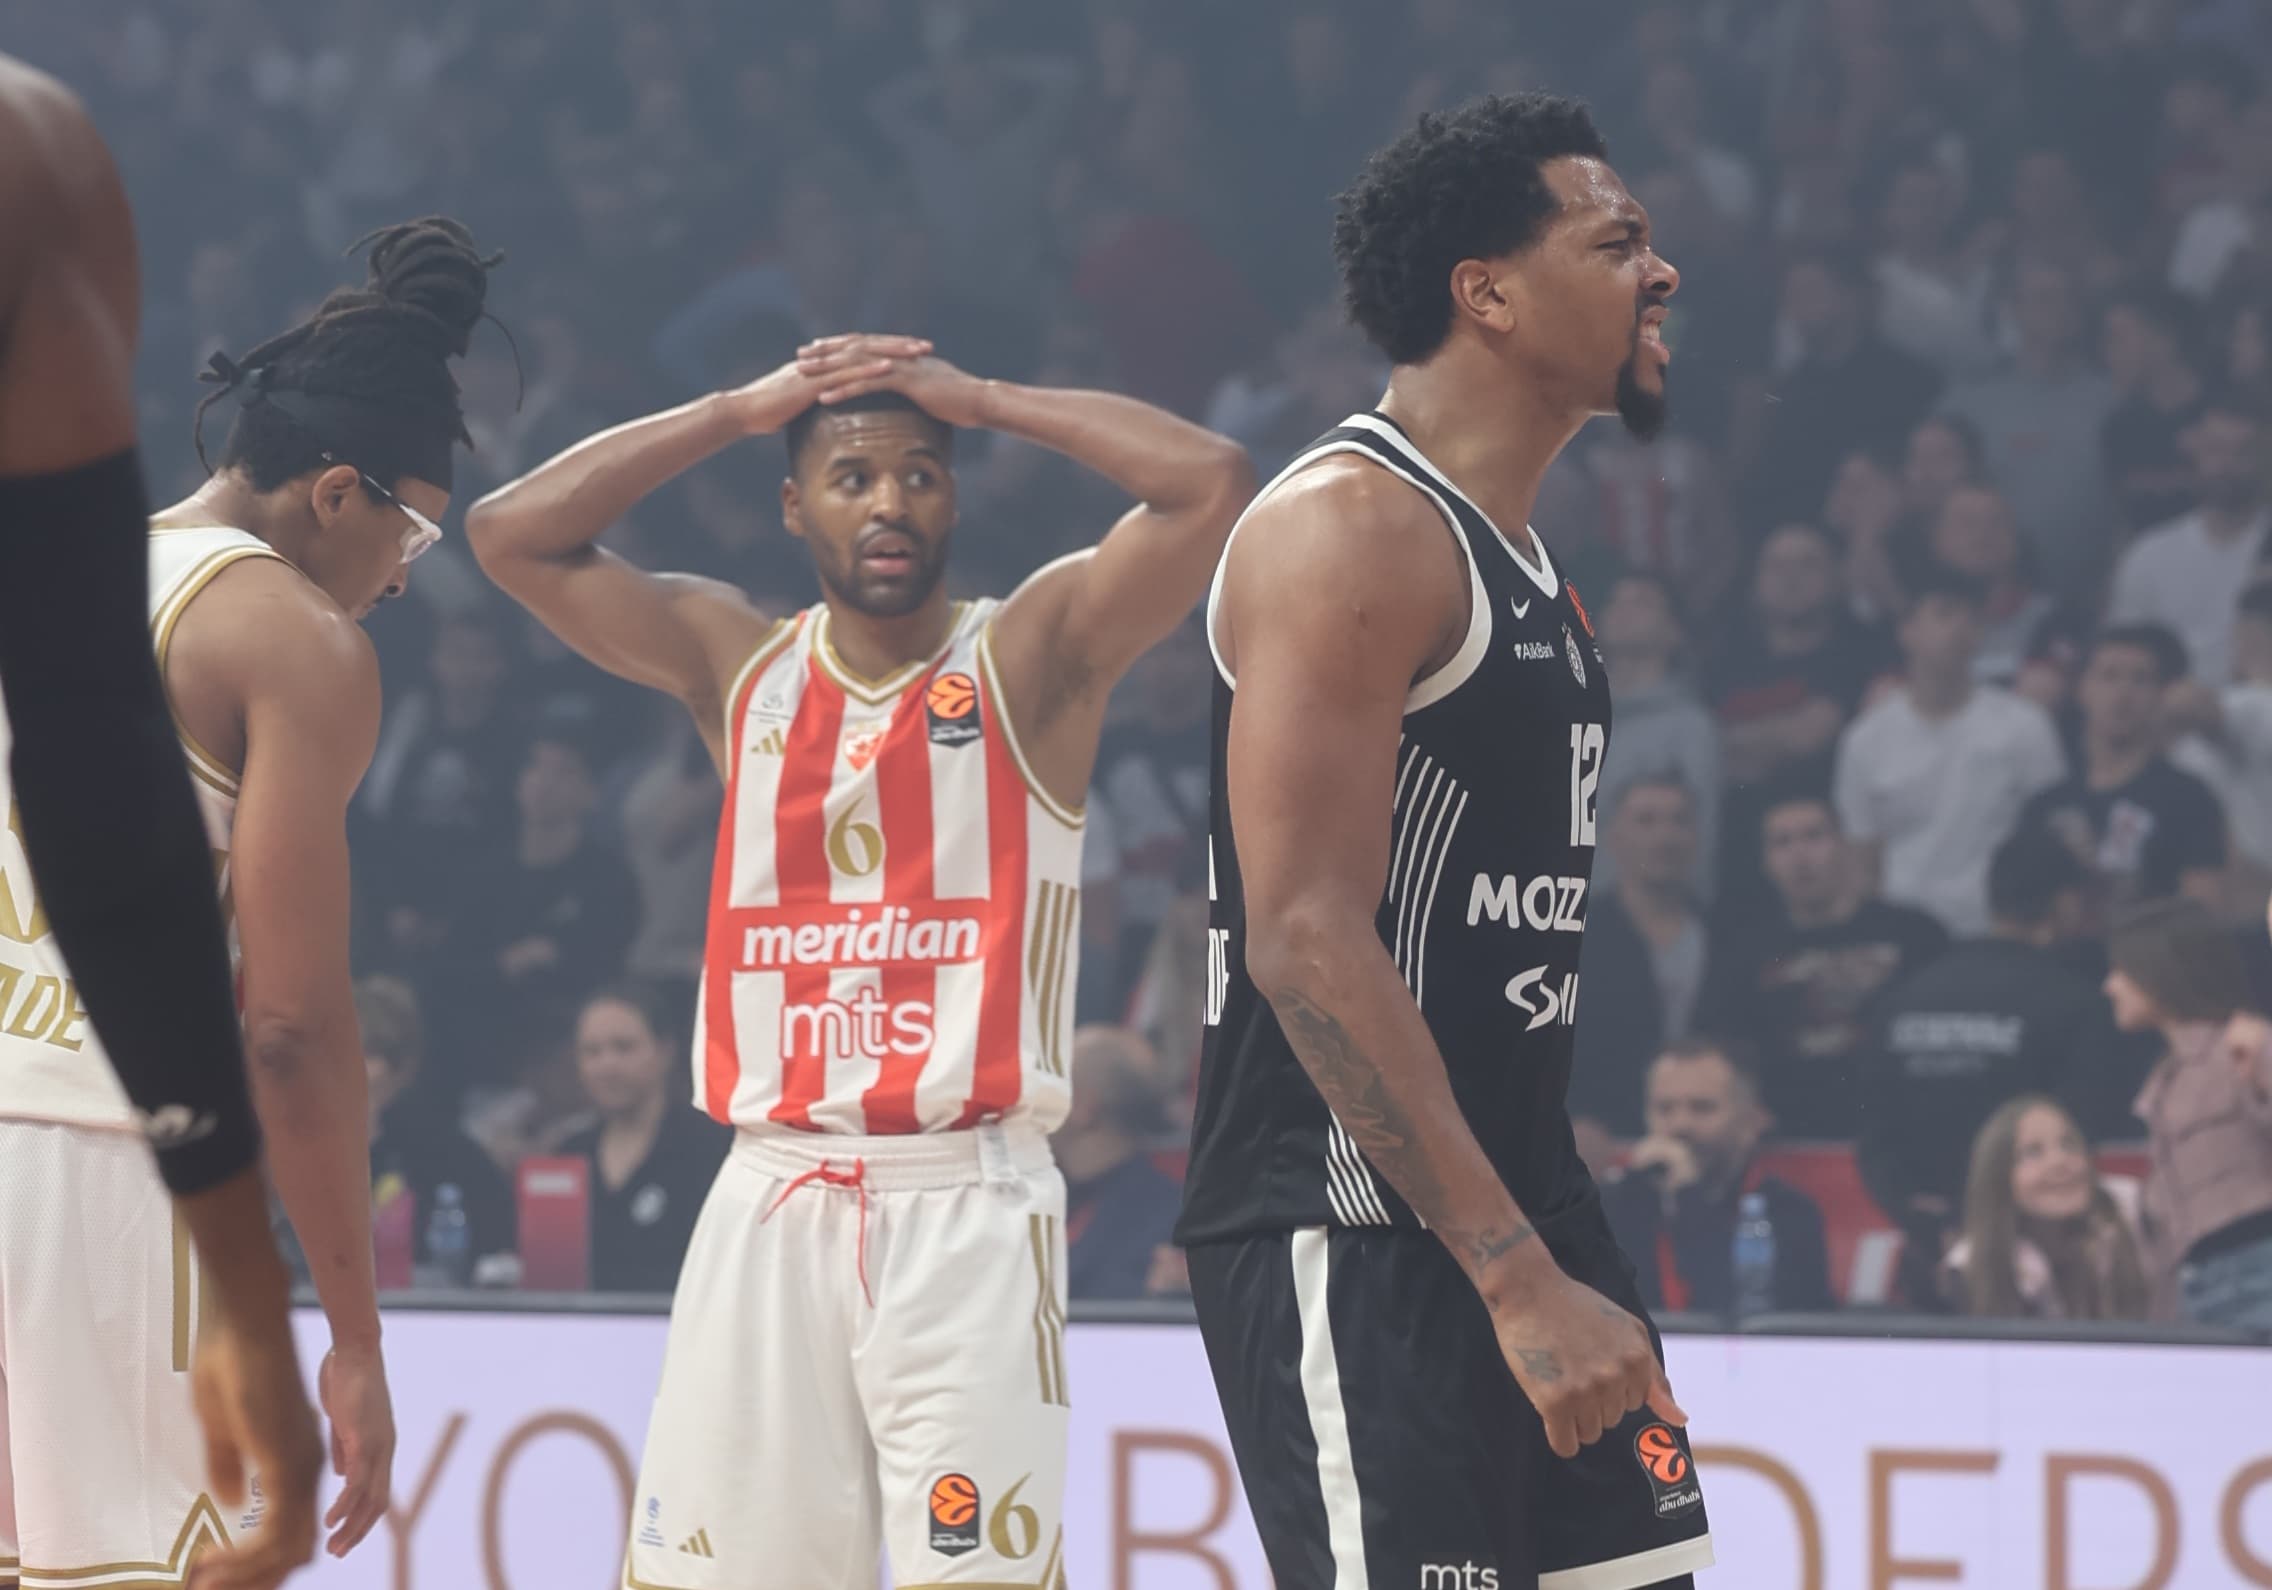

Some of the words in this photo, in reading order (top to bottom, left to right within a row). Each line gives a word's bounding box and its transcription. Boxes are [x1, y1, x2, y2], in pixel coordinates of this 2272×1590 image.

[1570, 723, 1604, 847] 12
[826, 794, 885, 877] 6
[742, 906, 980, 967] meridian
[1466, 872, 1588, 933] MOZZ
[780, 985, 936, 1060] mts
[988, 1470, 1041, 1561] 6
[1421, 1559, 1500, 1590] mts
